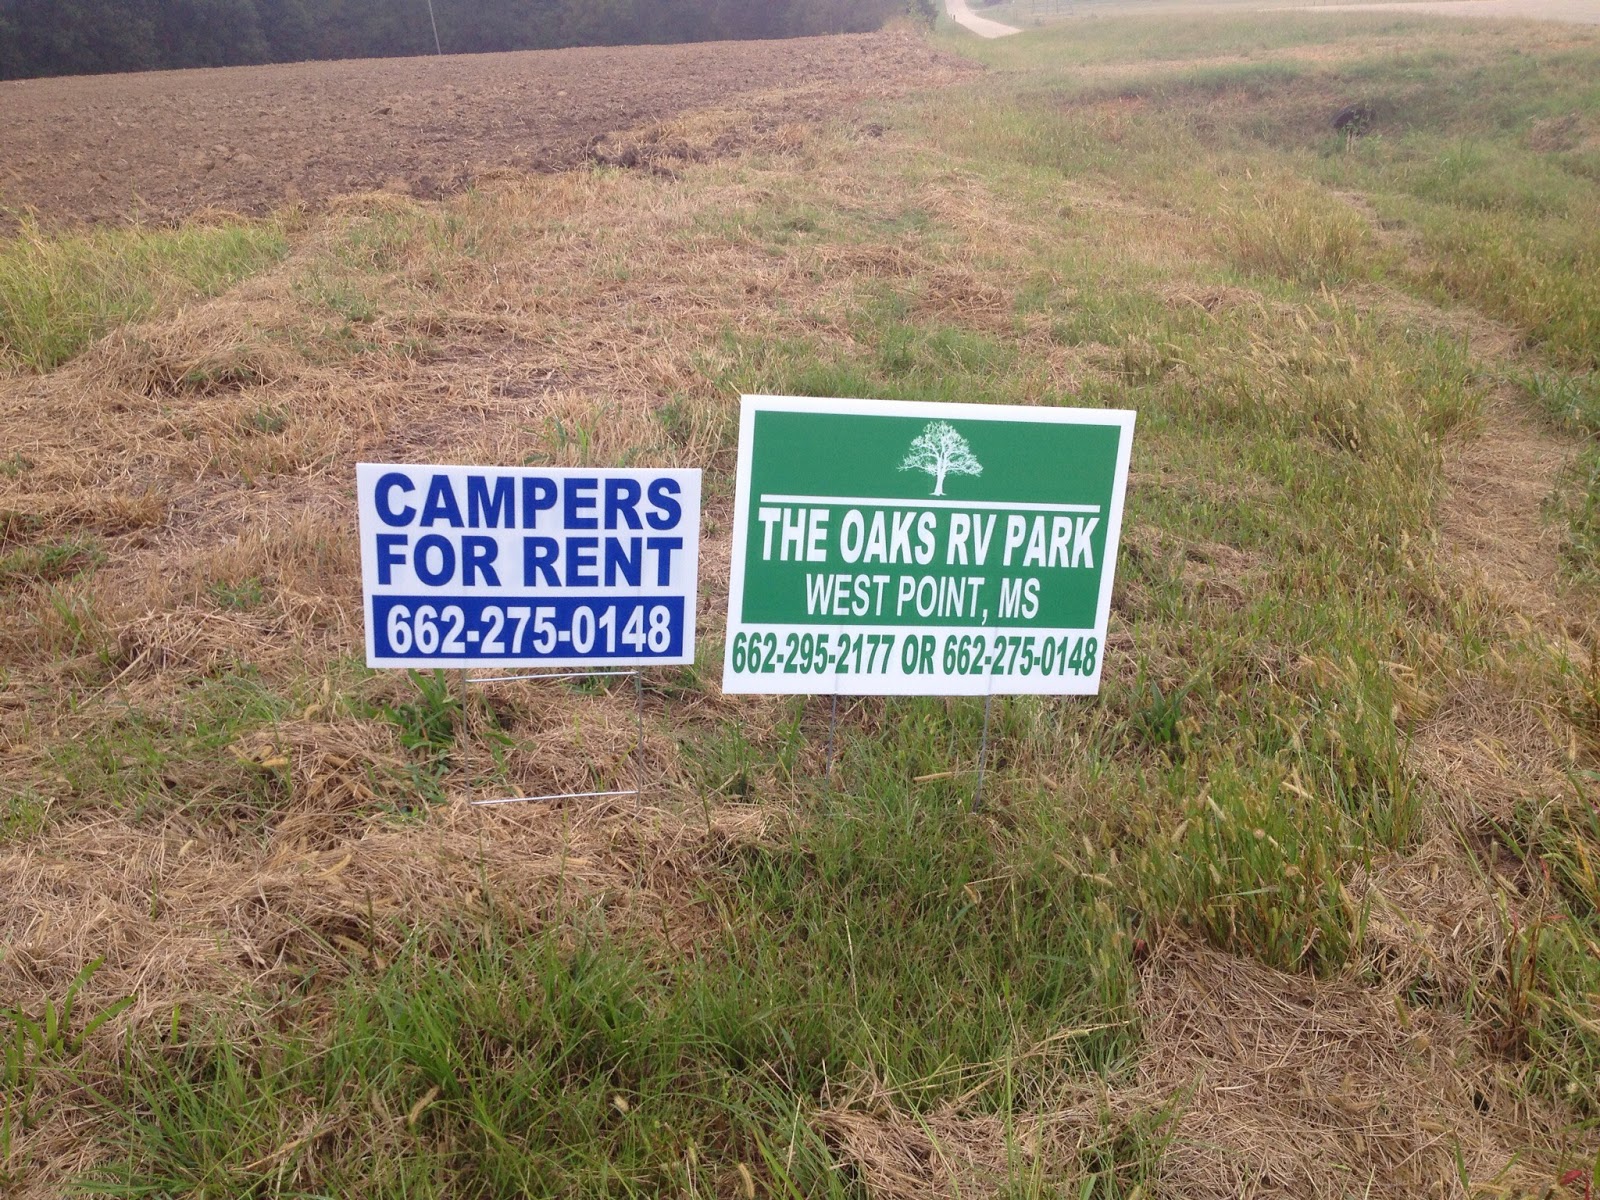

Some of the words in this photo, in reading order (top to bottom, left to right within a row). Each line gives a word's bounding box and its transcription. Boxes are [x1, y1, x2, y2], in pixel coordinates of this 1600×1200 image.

[374, 472, 682, 531] CAMPERS
[376, 533, 501, 587] FOR
[523, 536, 683, 587] RENT
[758, 507, 830, 562] THE
[840, 509, 936, 564] OAKS
[946, 513, 997, 566] RV
[1002, 514, 1100, 568] PARK
[806, 573, 889, 616] WEST
[896, 575, 988, 625] POINT,
[998, 578, 1040, 619] MS
[387, 604, 671, 654] 662-275-0148
[732, 632, 894, 674] 662-295-2177
[901, 634, 936, 675] OR
[943, 635, 1098, 677] 662-275-0148
